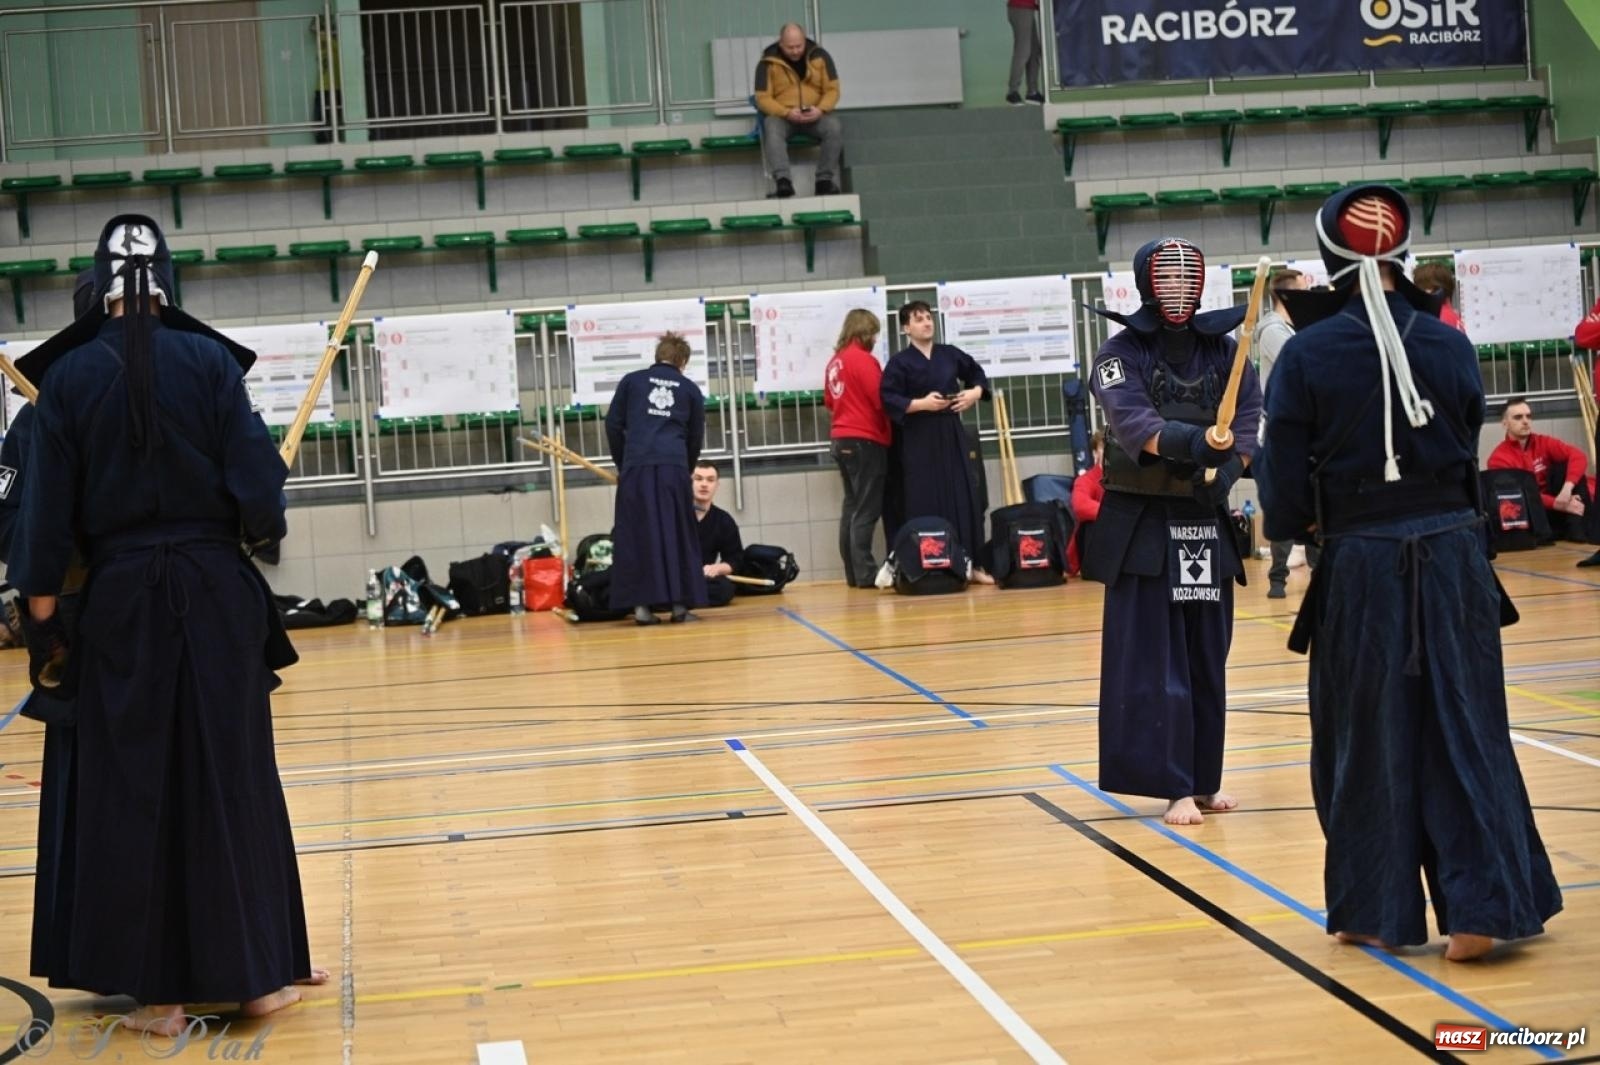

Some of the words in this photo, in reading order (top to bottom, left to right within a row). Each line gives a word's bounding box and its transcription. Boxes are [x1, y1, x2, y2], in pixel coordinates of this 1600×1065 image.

[1101, 0, 1298, 45] RACIBÓRZ
[1409, 27, 1481, 44] RACIBÓRZ
[1169, 526, 1219, 540] WARSZAWA
